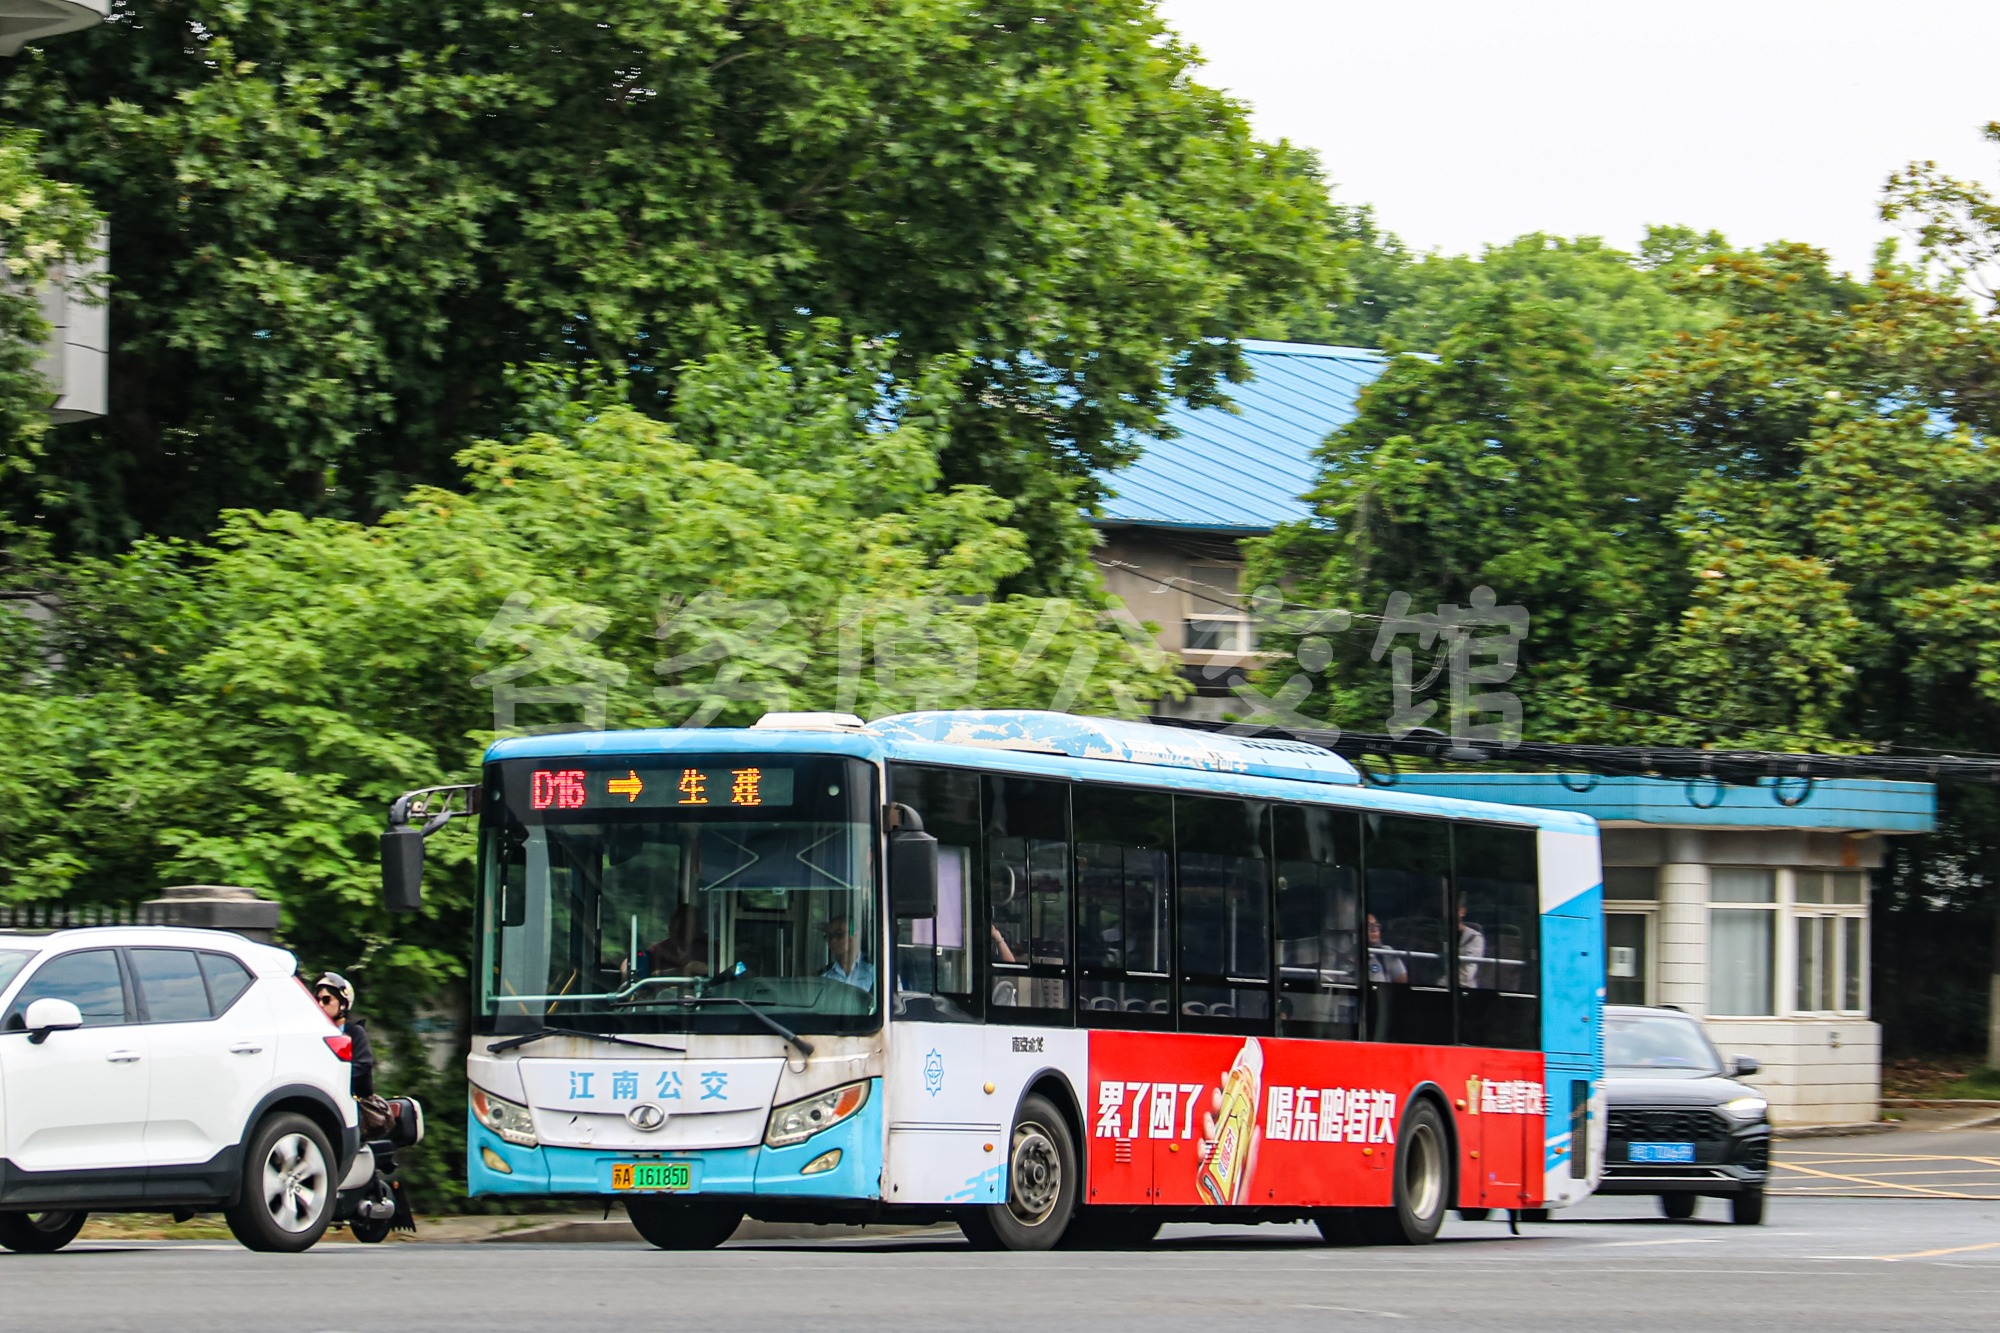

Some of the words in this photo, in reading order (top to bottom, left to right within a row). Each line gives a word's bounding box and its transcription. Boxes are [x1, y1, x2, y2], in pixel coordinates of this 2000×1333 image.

[533, 770, 586, 809] D16
[569, 1070, 728, 1100] 江南公交
[1095, 1080, 1204, 1140] 累了困了
[1265, 1086, 1397, 1144] 喝东鹏特饮
